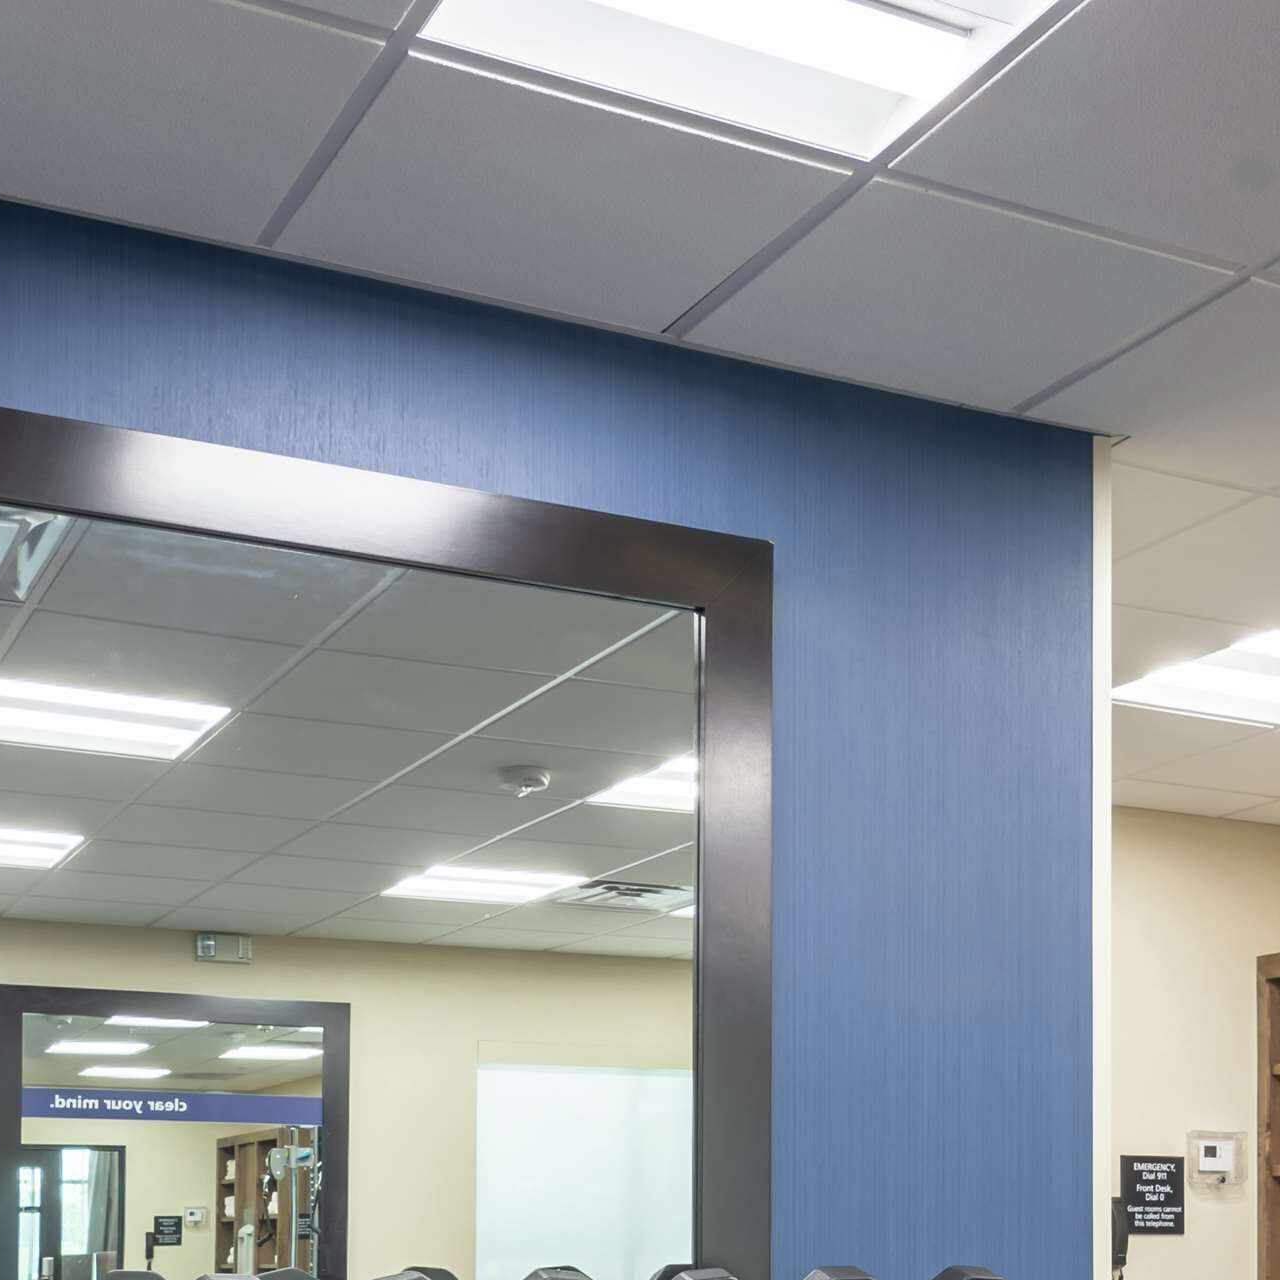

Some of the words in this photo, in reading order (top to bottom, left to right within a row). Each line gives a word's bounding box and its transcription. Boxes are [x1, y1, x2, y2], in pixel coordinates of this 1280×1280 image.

[1142, 1171, 1155, 1180] Dial
[1156, 1172, 1167, 1180] 911
[1136, 1184, 1154, 1192] Front
[1145, 1193, 1158, 1201] Dial
[1159, 1193, 1165, 1201] 0
[1127, 1204, 1144, 1213] Guest
